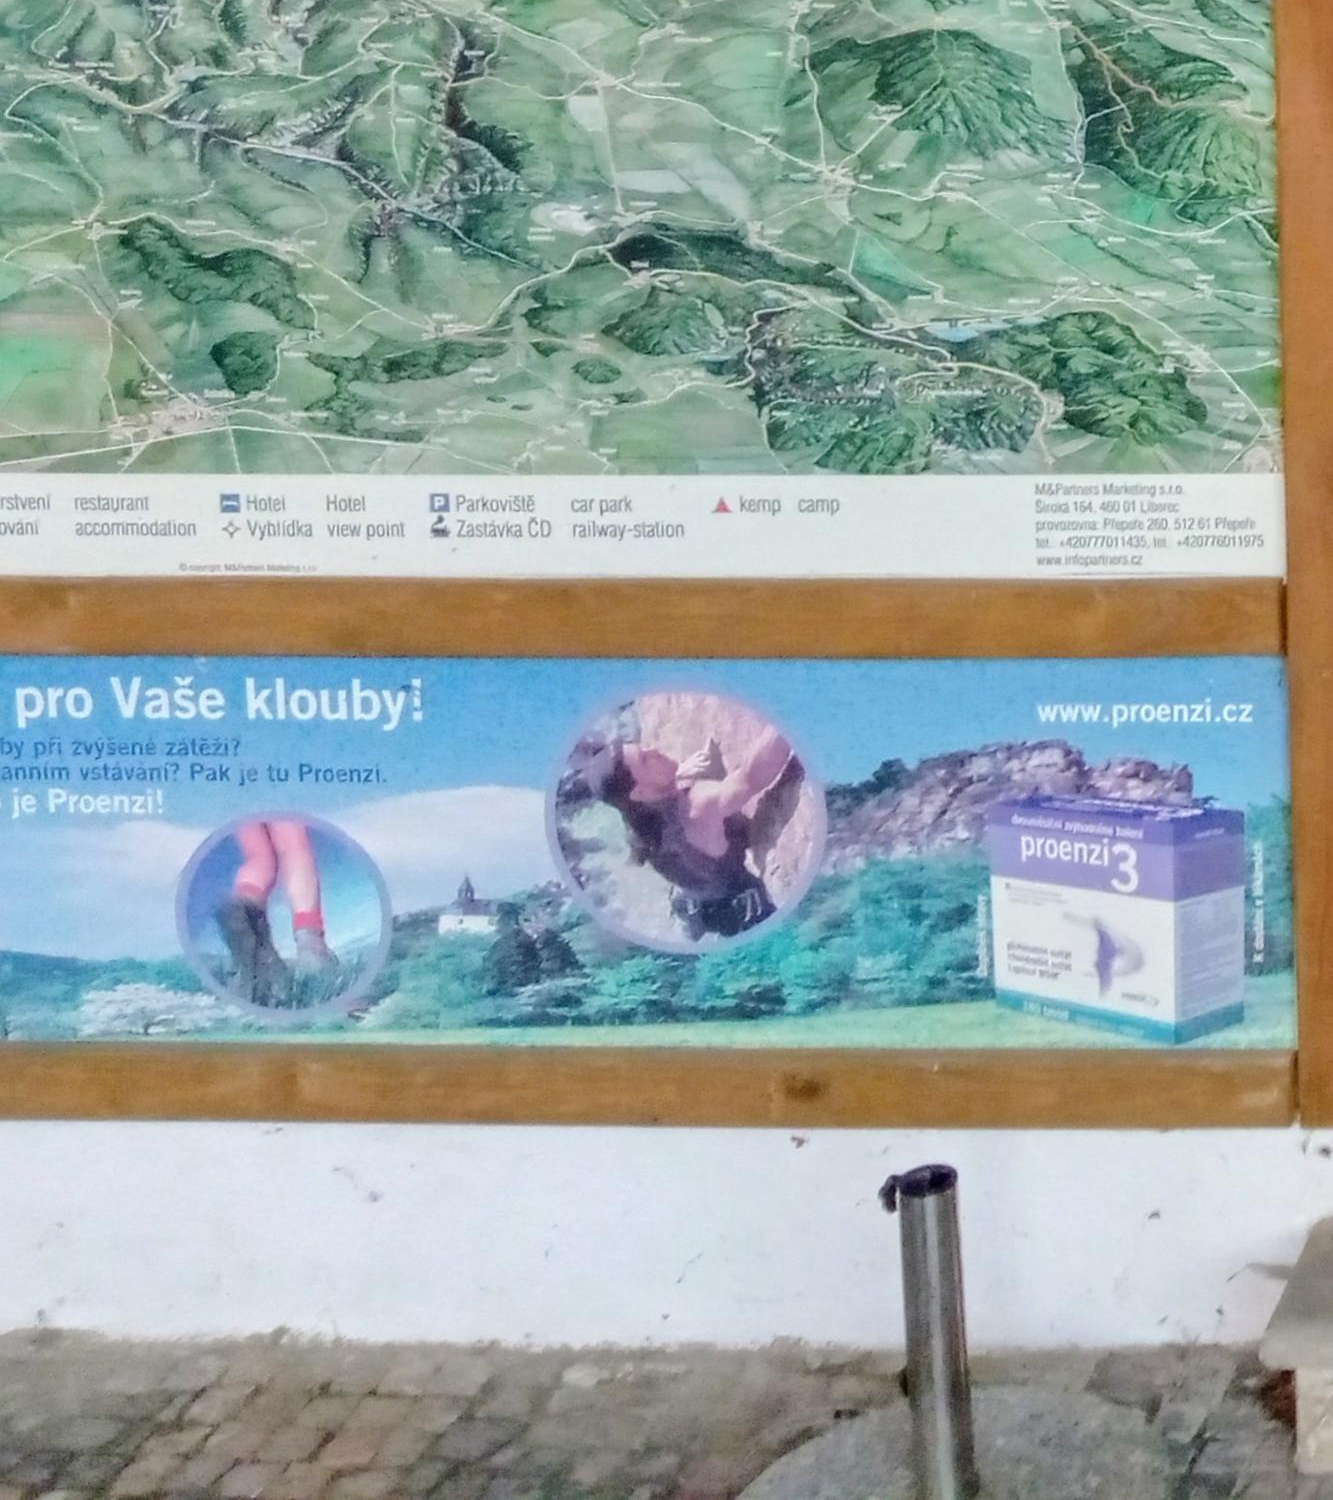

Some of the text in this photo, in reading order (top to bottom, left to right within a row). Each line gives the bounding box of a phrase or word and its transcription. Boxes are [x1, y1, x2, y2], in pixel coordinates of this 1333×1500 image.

[1035, 484, 1099, 496] M&Partners
[1103, 483, 1156, 498] Marketing
[247, 496, 286, 511] Hotel
[326, 495, 366, 511] Hotel
[456, 494, 535, 512] Parkoviště
[571, 498, 594, 512] car
[599, 496, 632, 515] park
[739, 496, 781, 517] kemp
[798, 497, 840, 517] camp
[1099, 502, 1120, 513] 460
[1123, 502, 1136, 513] 01
[1140, 501, 1180, 513] Liberec
[75, 519, 197, 537] accommodation
[247, 519, 313, 540] Vyhlídka
[327, 520, 362, 537] view
[366, 521, 405, 540] point
[456, 520, 523, 537] Zastávka
[527, 517, 551, 538] ČD
[572, 521, 685, 541] railway-station
[1174, 518, 1195, 531] 512
[1036, 555, 1143, 567] www.infopartners.cz
[15, 675, 424, 732] pro Vaše klouby!
[1037, 697, 1254, 728] www.proenzi.cz
[34, 737, 62, 759] při
[71, 736, 157, 760] zvýšené
[79, 763, 180, 782] vstávání?
[190, 763, 230, 783] Pak
[239, 764, 259, 787] je
[267, 765, 289, 783] tu
[299, 764, 388, 784] Proenzi.
[12, 788, 164, 819] je Proenzi!
[1020, 834, 1139, 893] proenzi 3
